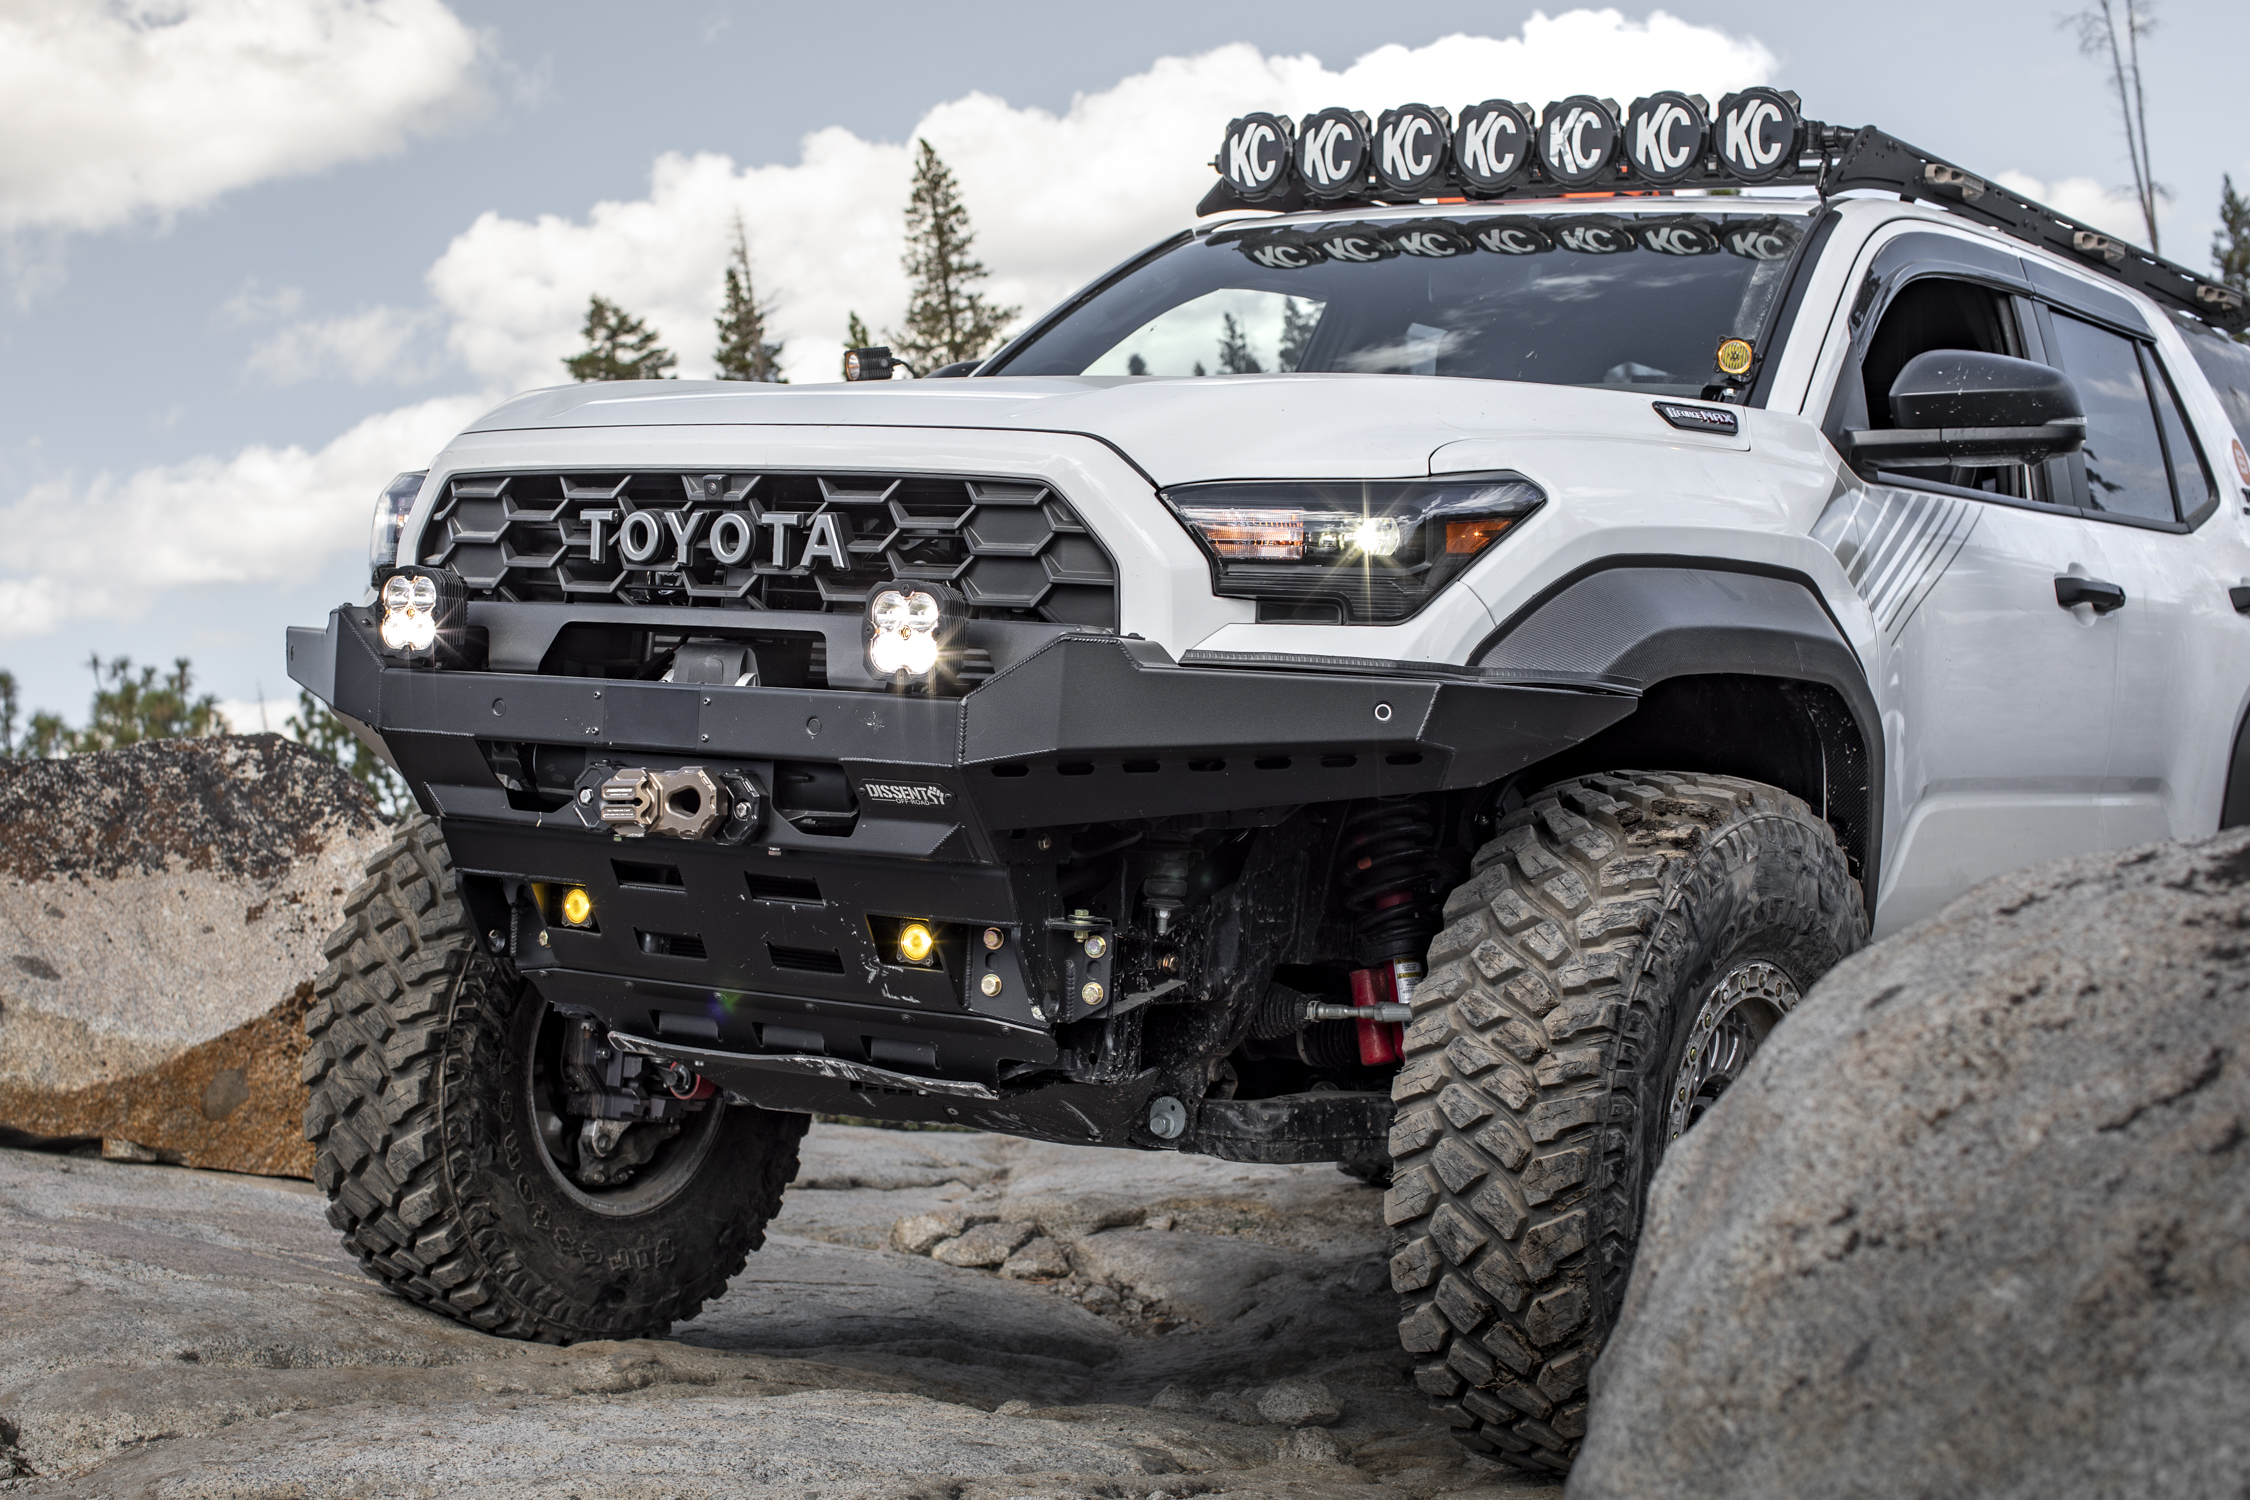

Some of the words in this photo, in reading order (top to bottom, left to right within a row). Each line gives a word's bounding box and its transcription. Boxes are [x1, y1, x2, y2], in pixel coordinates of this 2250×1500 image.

[1230, 123, 1276, 188] KC
[1303, 119, 1353, 185] KC
[1382, 115, 1433, 181] KC
[1463, 111, 1517, 177] KC
[1549, 107, 1602, 174] KC
[1635, 102, 1691, 173] KC
[1725, 99, 1783, 170] KC
[579, 509, 850, 571] TOYOTA
[865, 783, 926, 801] DISSENT
